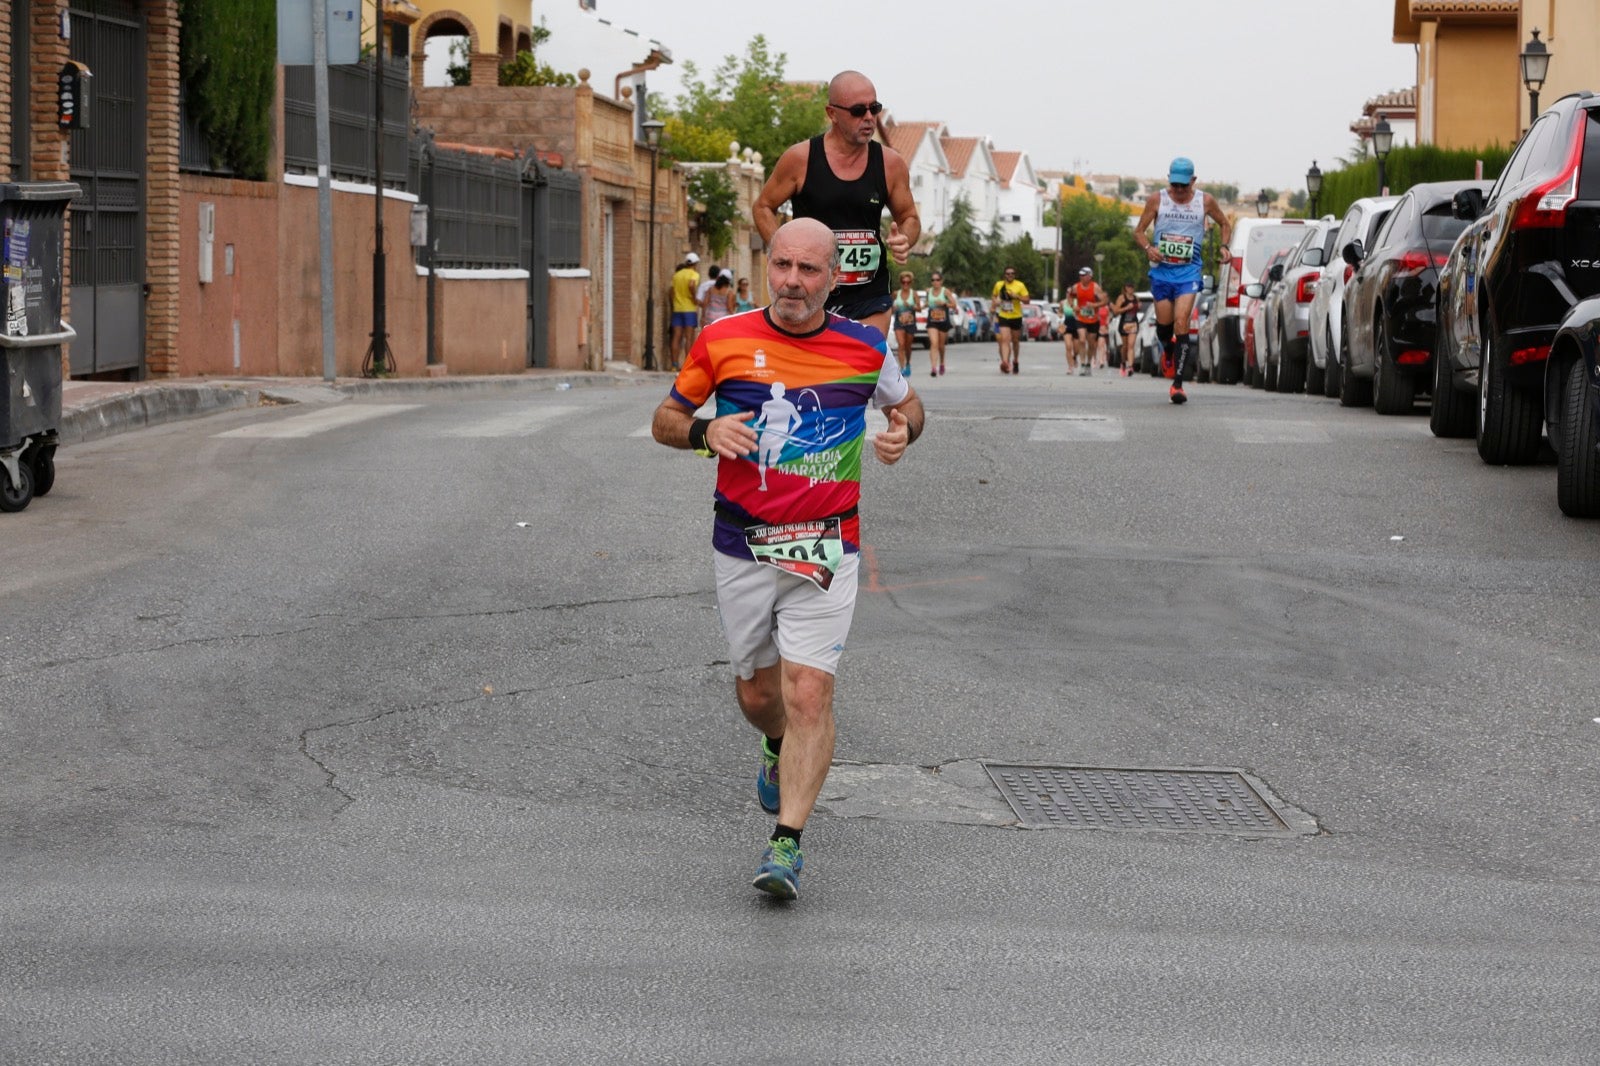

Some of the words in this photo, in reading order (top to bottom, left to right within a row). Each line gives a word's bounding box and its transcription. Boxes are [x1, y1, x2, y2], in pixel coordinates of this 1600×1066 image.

[1160, 243, 1191, 256] 1057
[803, 450, 842, 464] MEDIA
[767, 525, 784, 535] GRAN
[785, 522, 806, 532] PREMIO
[807, 521, 815, 530] DE
